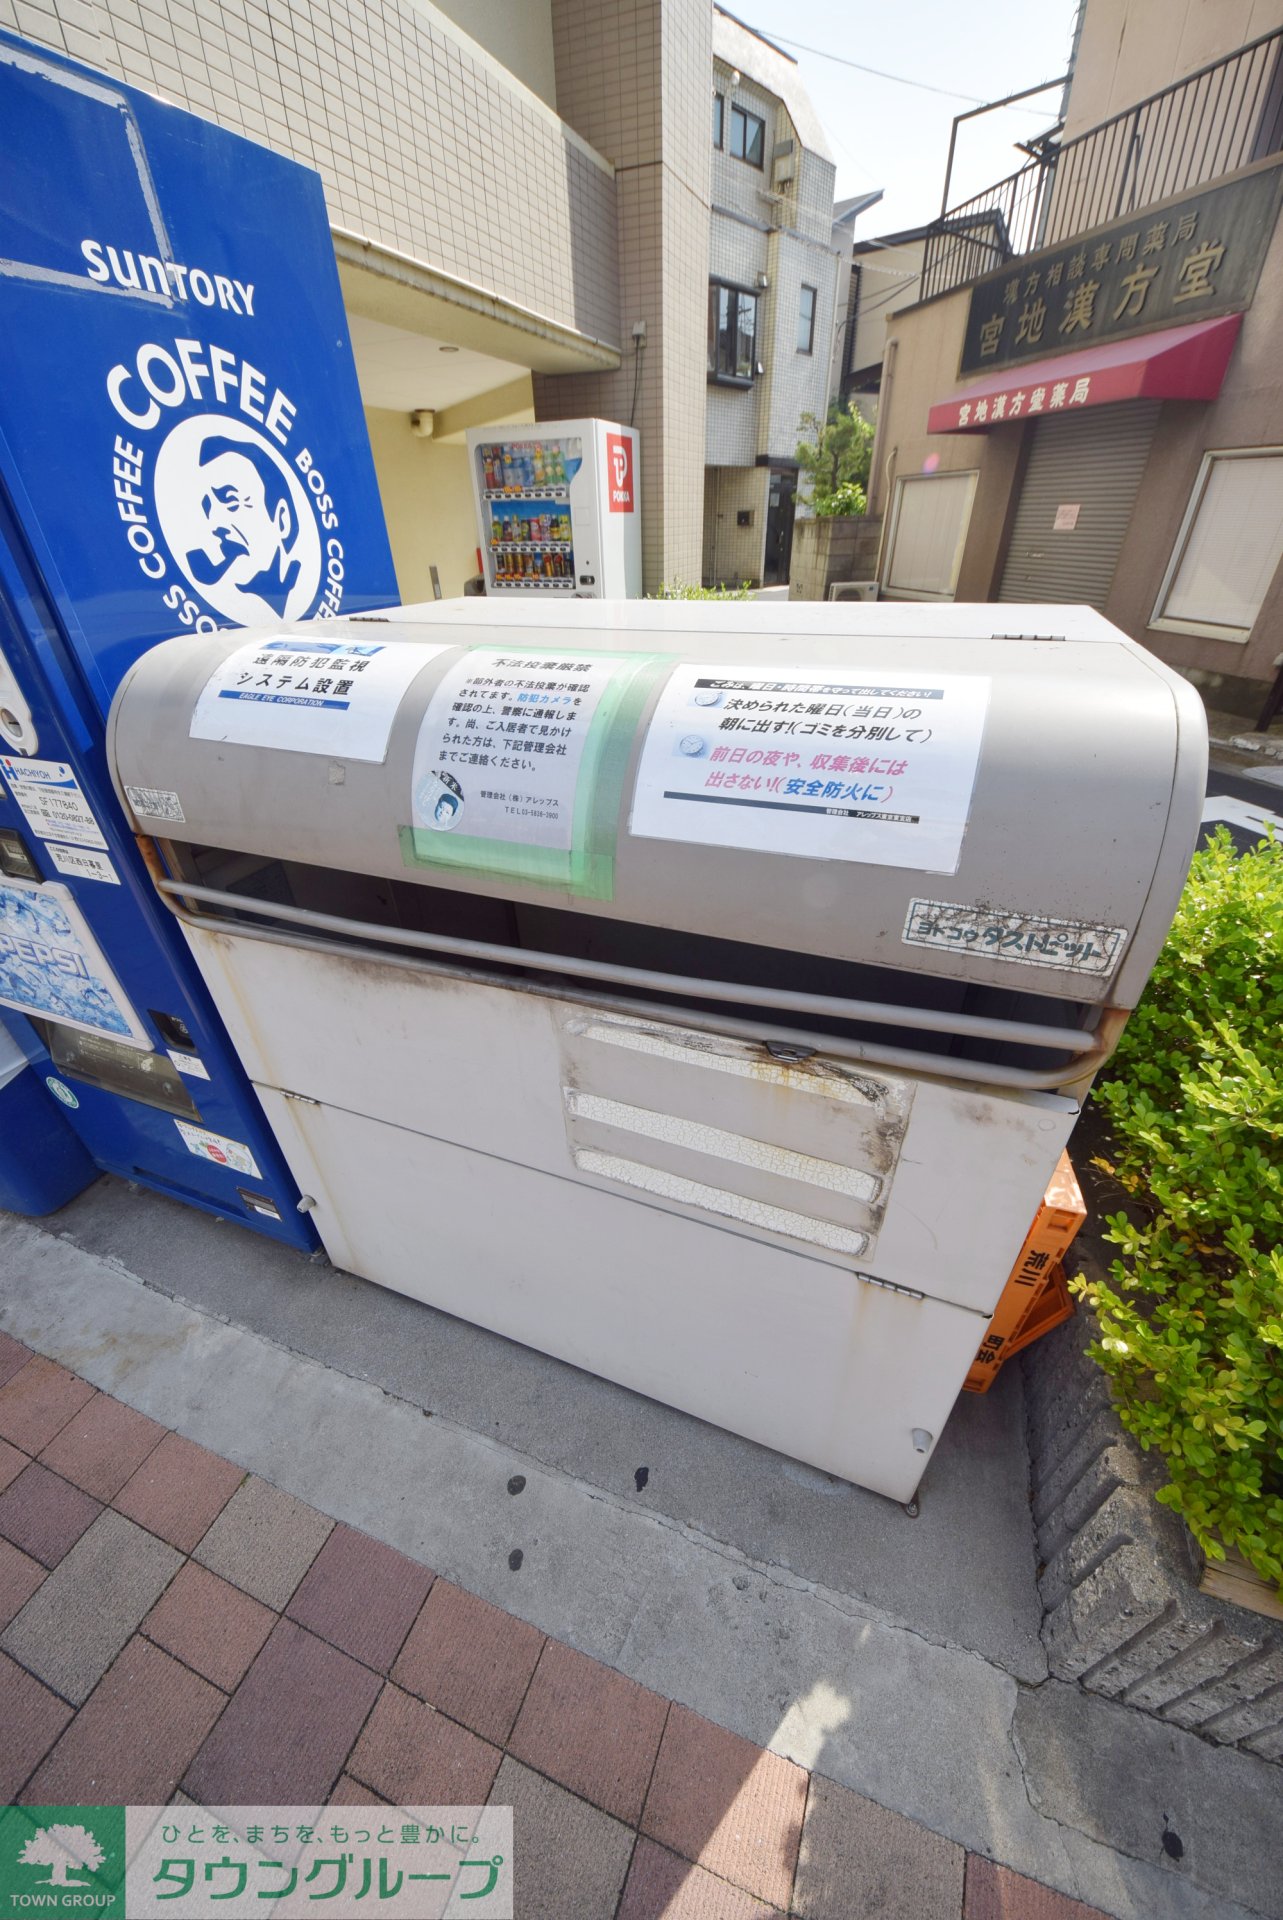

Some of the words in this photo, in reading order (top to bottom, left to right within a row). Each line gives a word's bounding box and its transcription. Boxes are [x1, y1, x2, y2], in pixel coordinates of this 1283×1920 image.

[979, 239, 1226, 358] 宮地漢方堂
[106, 338, 298, 446] COFFEE
[957, 377, 1092, 428] 宮地漢方堂薬局
[295, 447, 339, 530] BOSS
[612, 490, 630, 502] POKKA
[113, 435, 167, 580] COFFEE
[252, 653, 371, 673] 遠隔防犯監視
[491, 658, 592, 672] 不法投棄厳禁
[236, 671, 354, 696] システム設置
[239, 692, 261, 700] EAGLE
[261, 694, 275, 702] EYE
[276, 696, 324, 707] CORPORATION
[451, 701, 577, 721] 確認の上、警察に通報しま
[447, 716, 572, 738] す。尚、ご入居者で見かけ
[442, 732, 567, 756] られた方は、下記管理会社
[438, 750, 537, 772] までご連絡ください。
[709, 745, 909, 776] 前日の夜や、収集後には
[1014, 1250, 1050, 1287] 荒川
